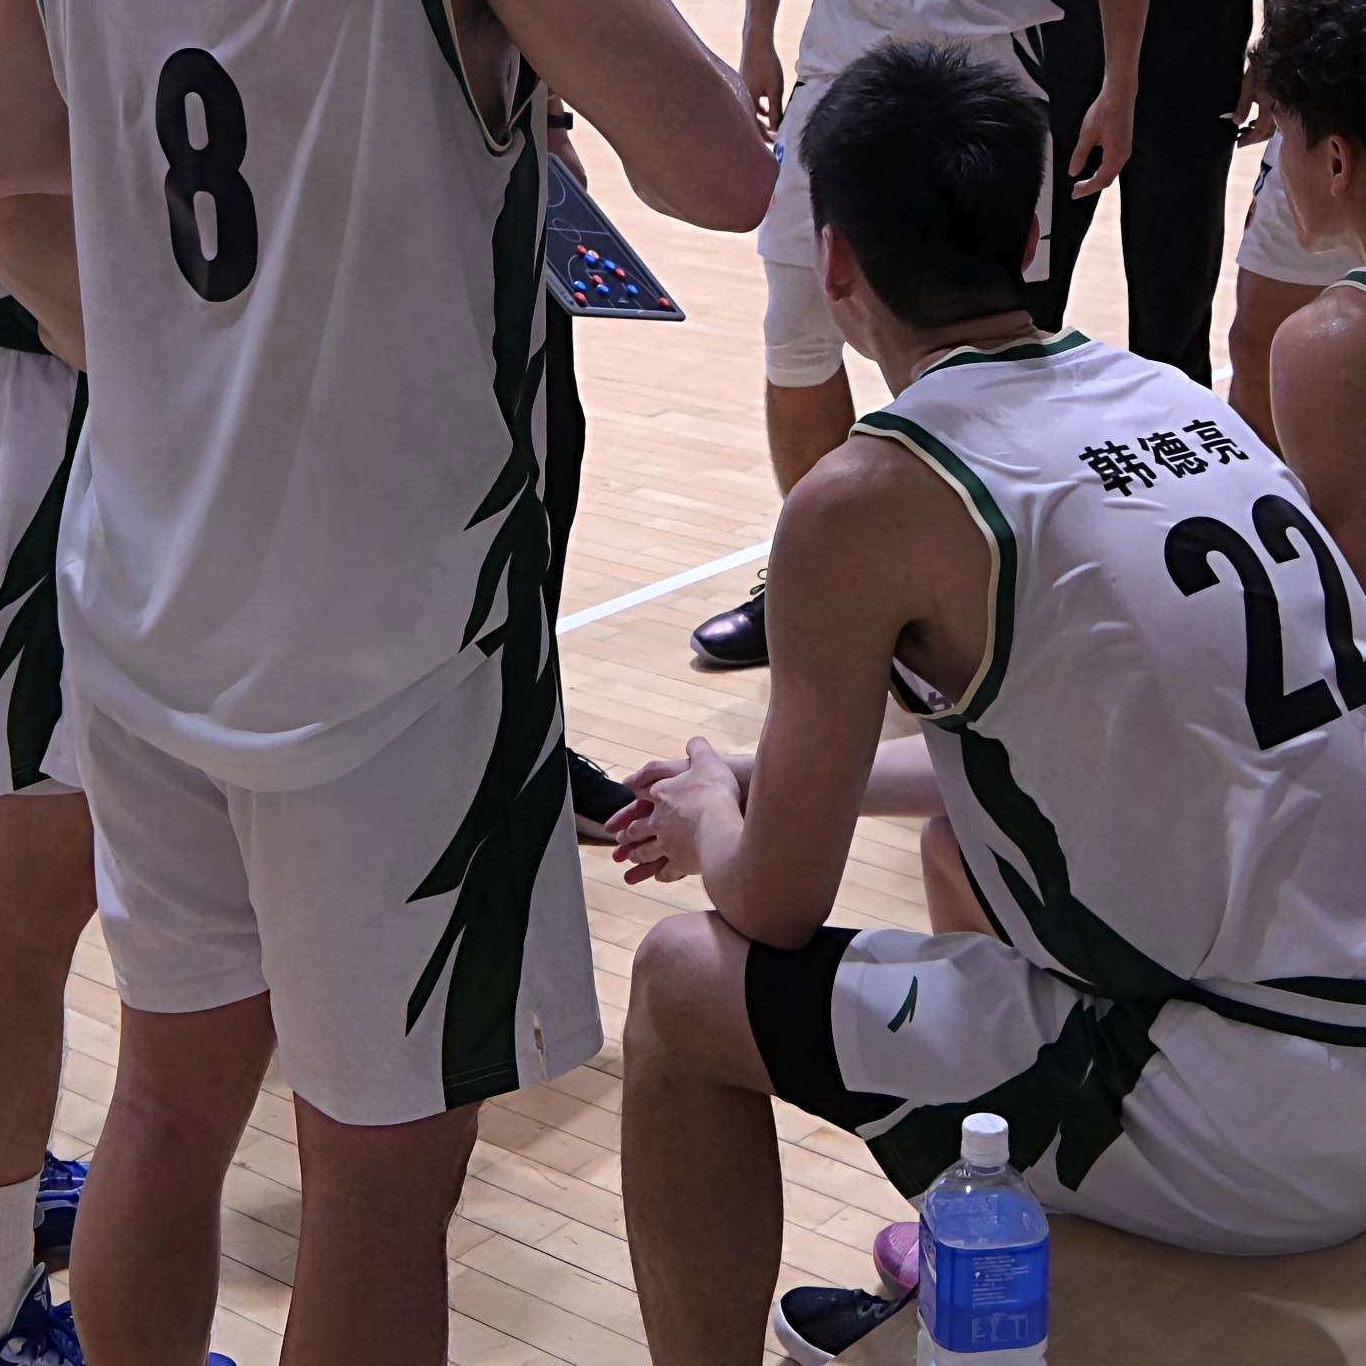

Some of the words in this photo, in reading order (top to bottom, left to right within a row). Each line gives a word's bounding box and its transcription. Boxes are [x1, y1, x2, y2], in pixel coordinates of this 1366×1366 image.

[155, 47, 259, 304] 8
[1078, 418, 1250, 497] 韩德亮
